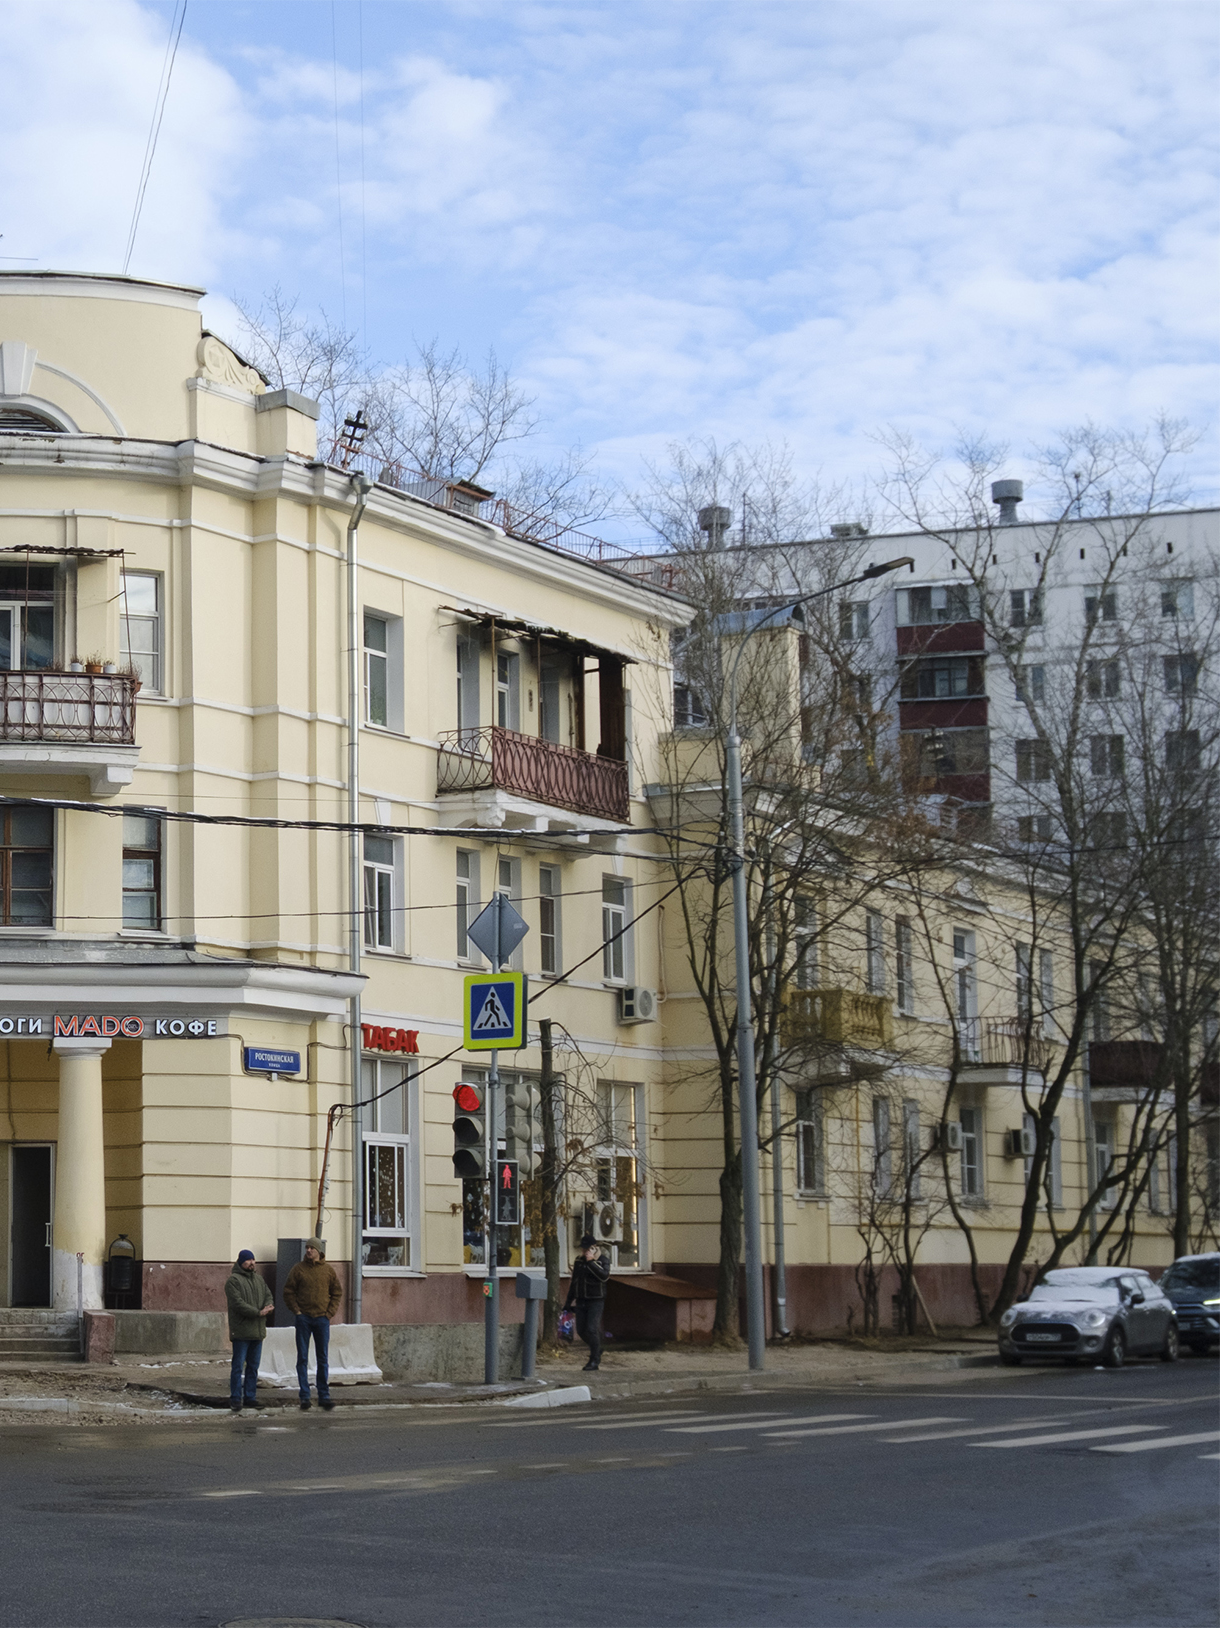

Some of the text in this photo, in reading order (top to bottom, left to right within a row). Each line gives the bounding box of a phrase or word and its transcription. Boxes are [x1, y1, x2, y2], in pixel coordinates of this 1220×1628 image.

[54, 1015, 144, 1037] MADO
[155, 1019, 217, 1035] КОФЕ
[361, 1023, 420, 1053] ТАБАК
